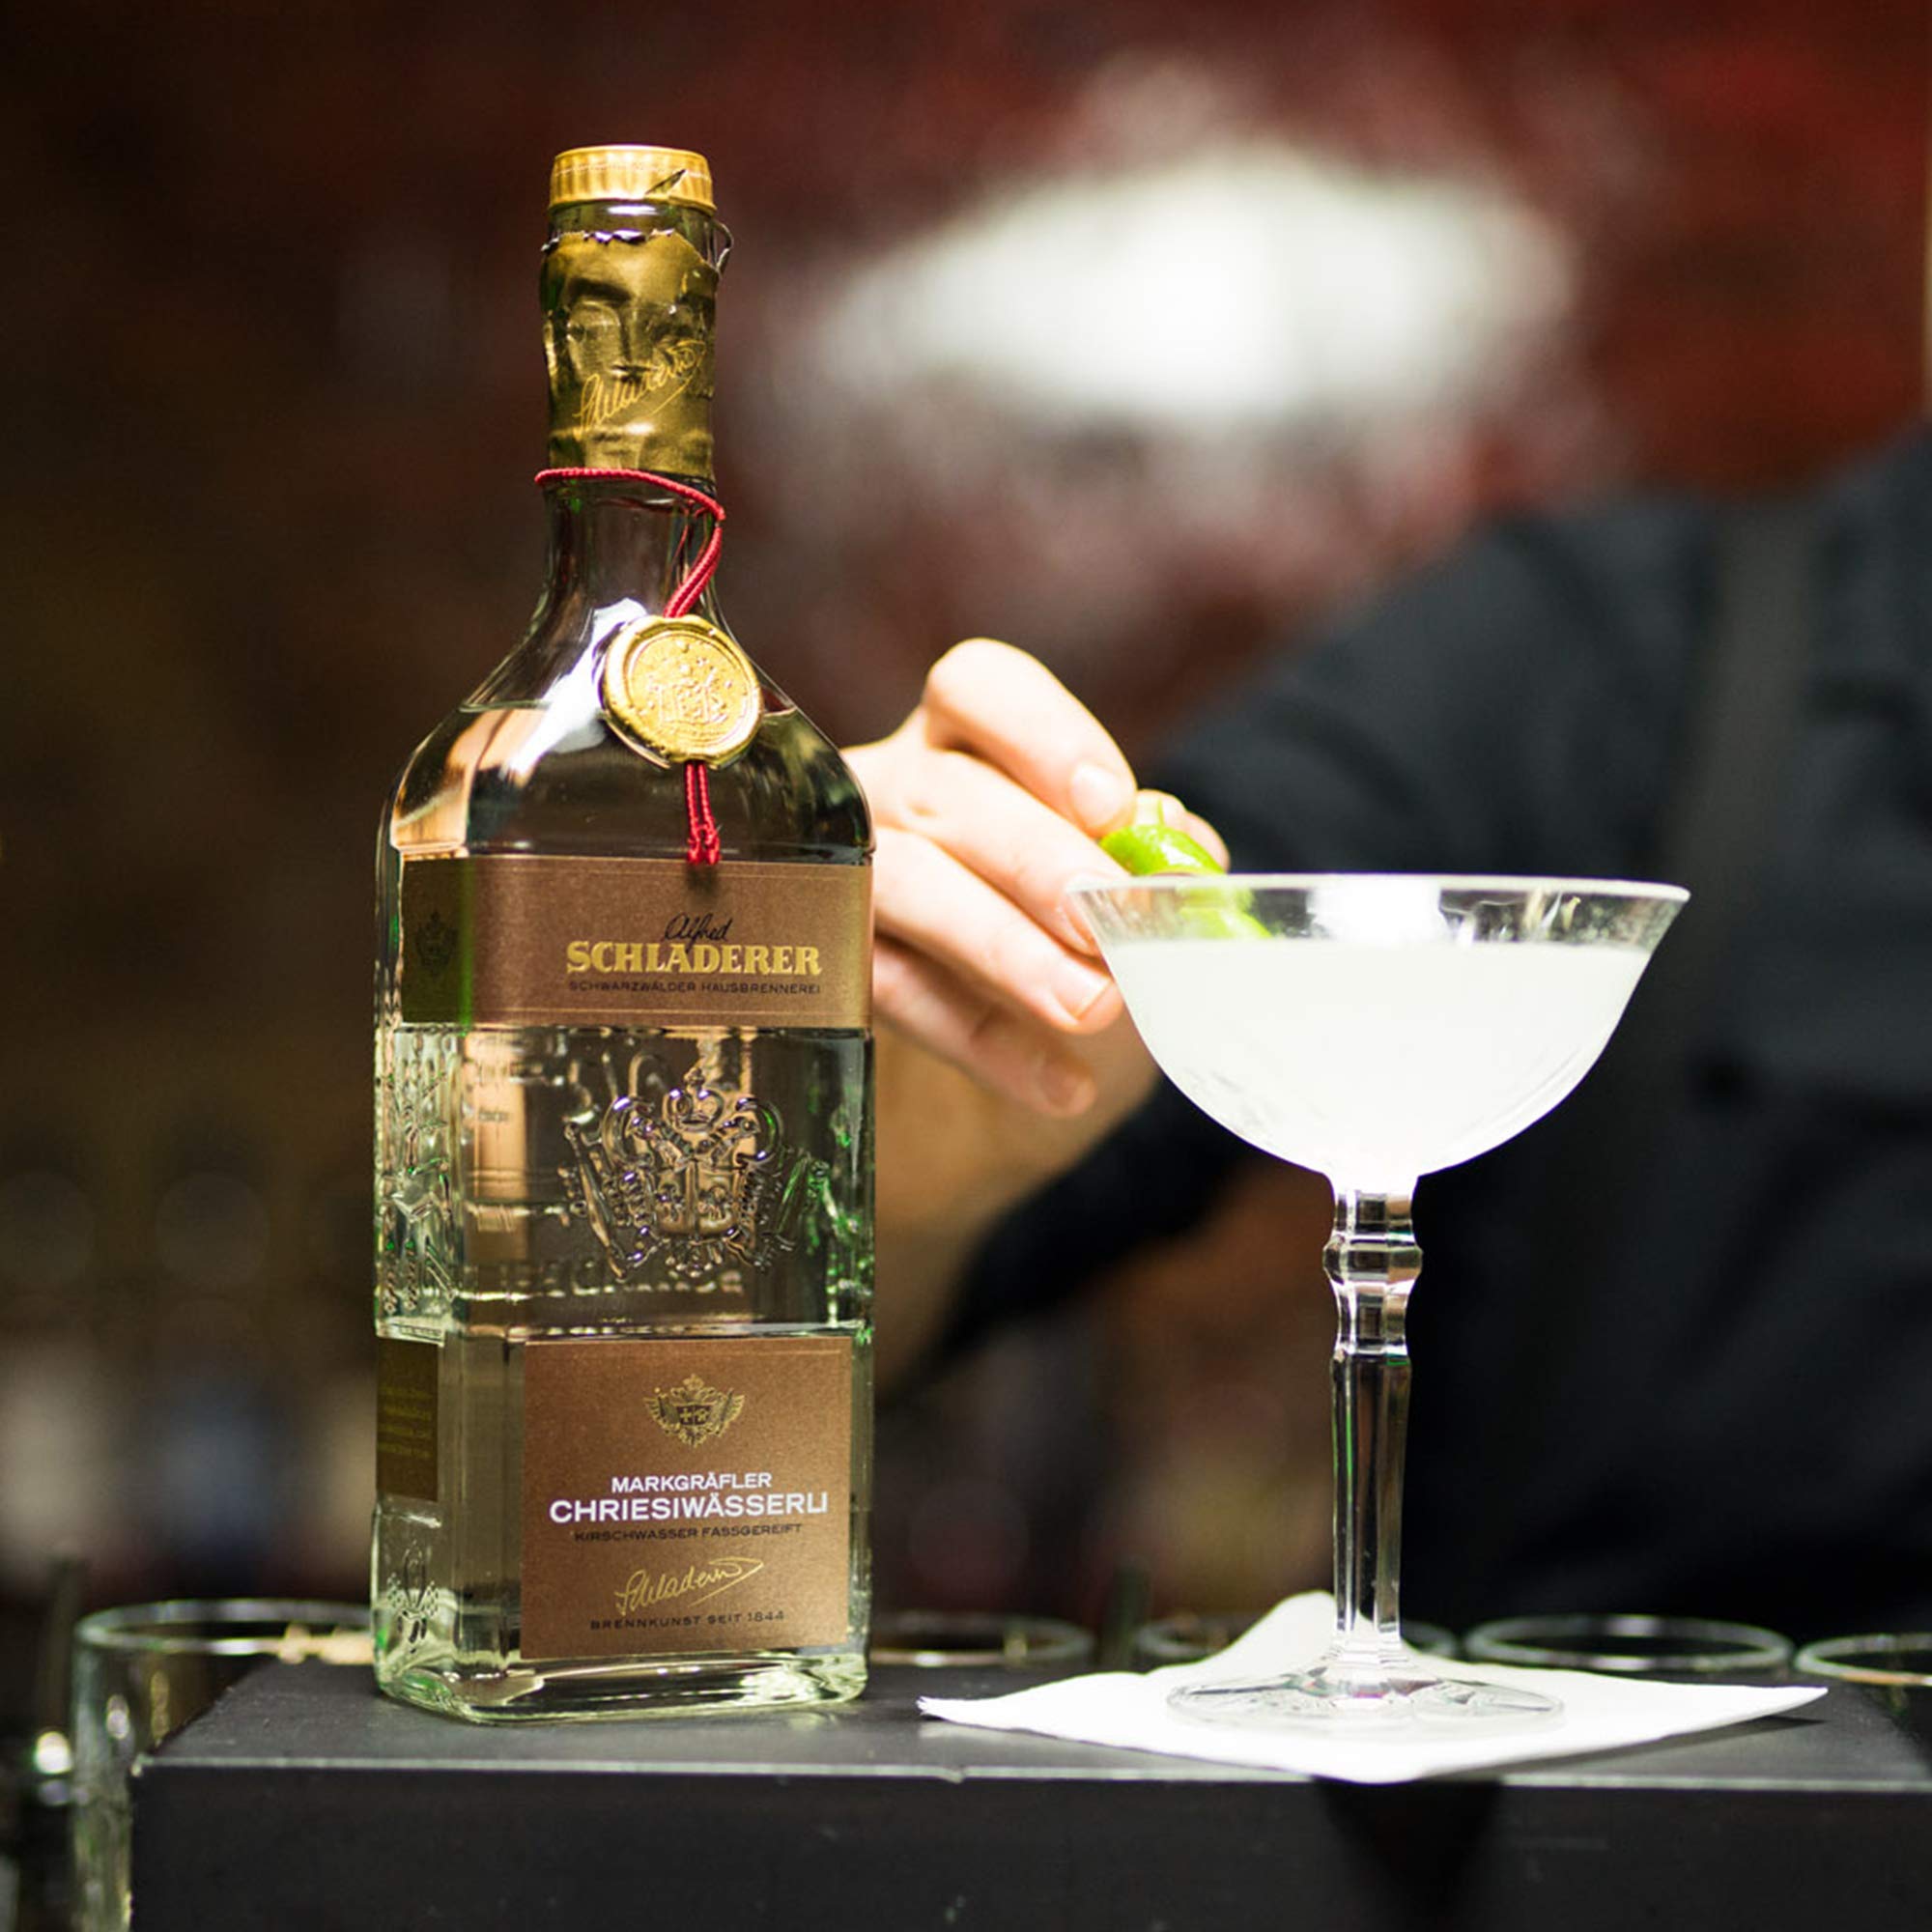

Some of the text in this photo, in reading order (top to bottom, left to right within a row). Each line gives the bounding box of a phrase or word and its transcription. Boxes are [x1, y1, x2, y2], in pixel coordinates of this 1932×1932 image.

[663, 914, 732, 954] Alfred
[566, 941, 822, 976] SCHLADERER
[701, 981, 820, 995] HAUSBRENNEREI
[611, 1471, 772, 1493] MARKGRÄFLER
[549, 1492, 828, 1523] CHRIESIWÄSSERLI
[574, 1522, 802, 1543] KIRSCHWASSER FASSGEREIFT
[590, 1609, 784, 1631] BRENNKUNST SEIT 1844
